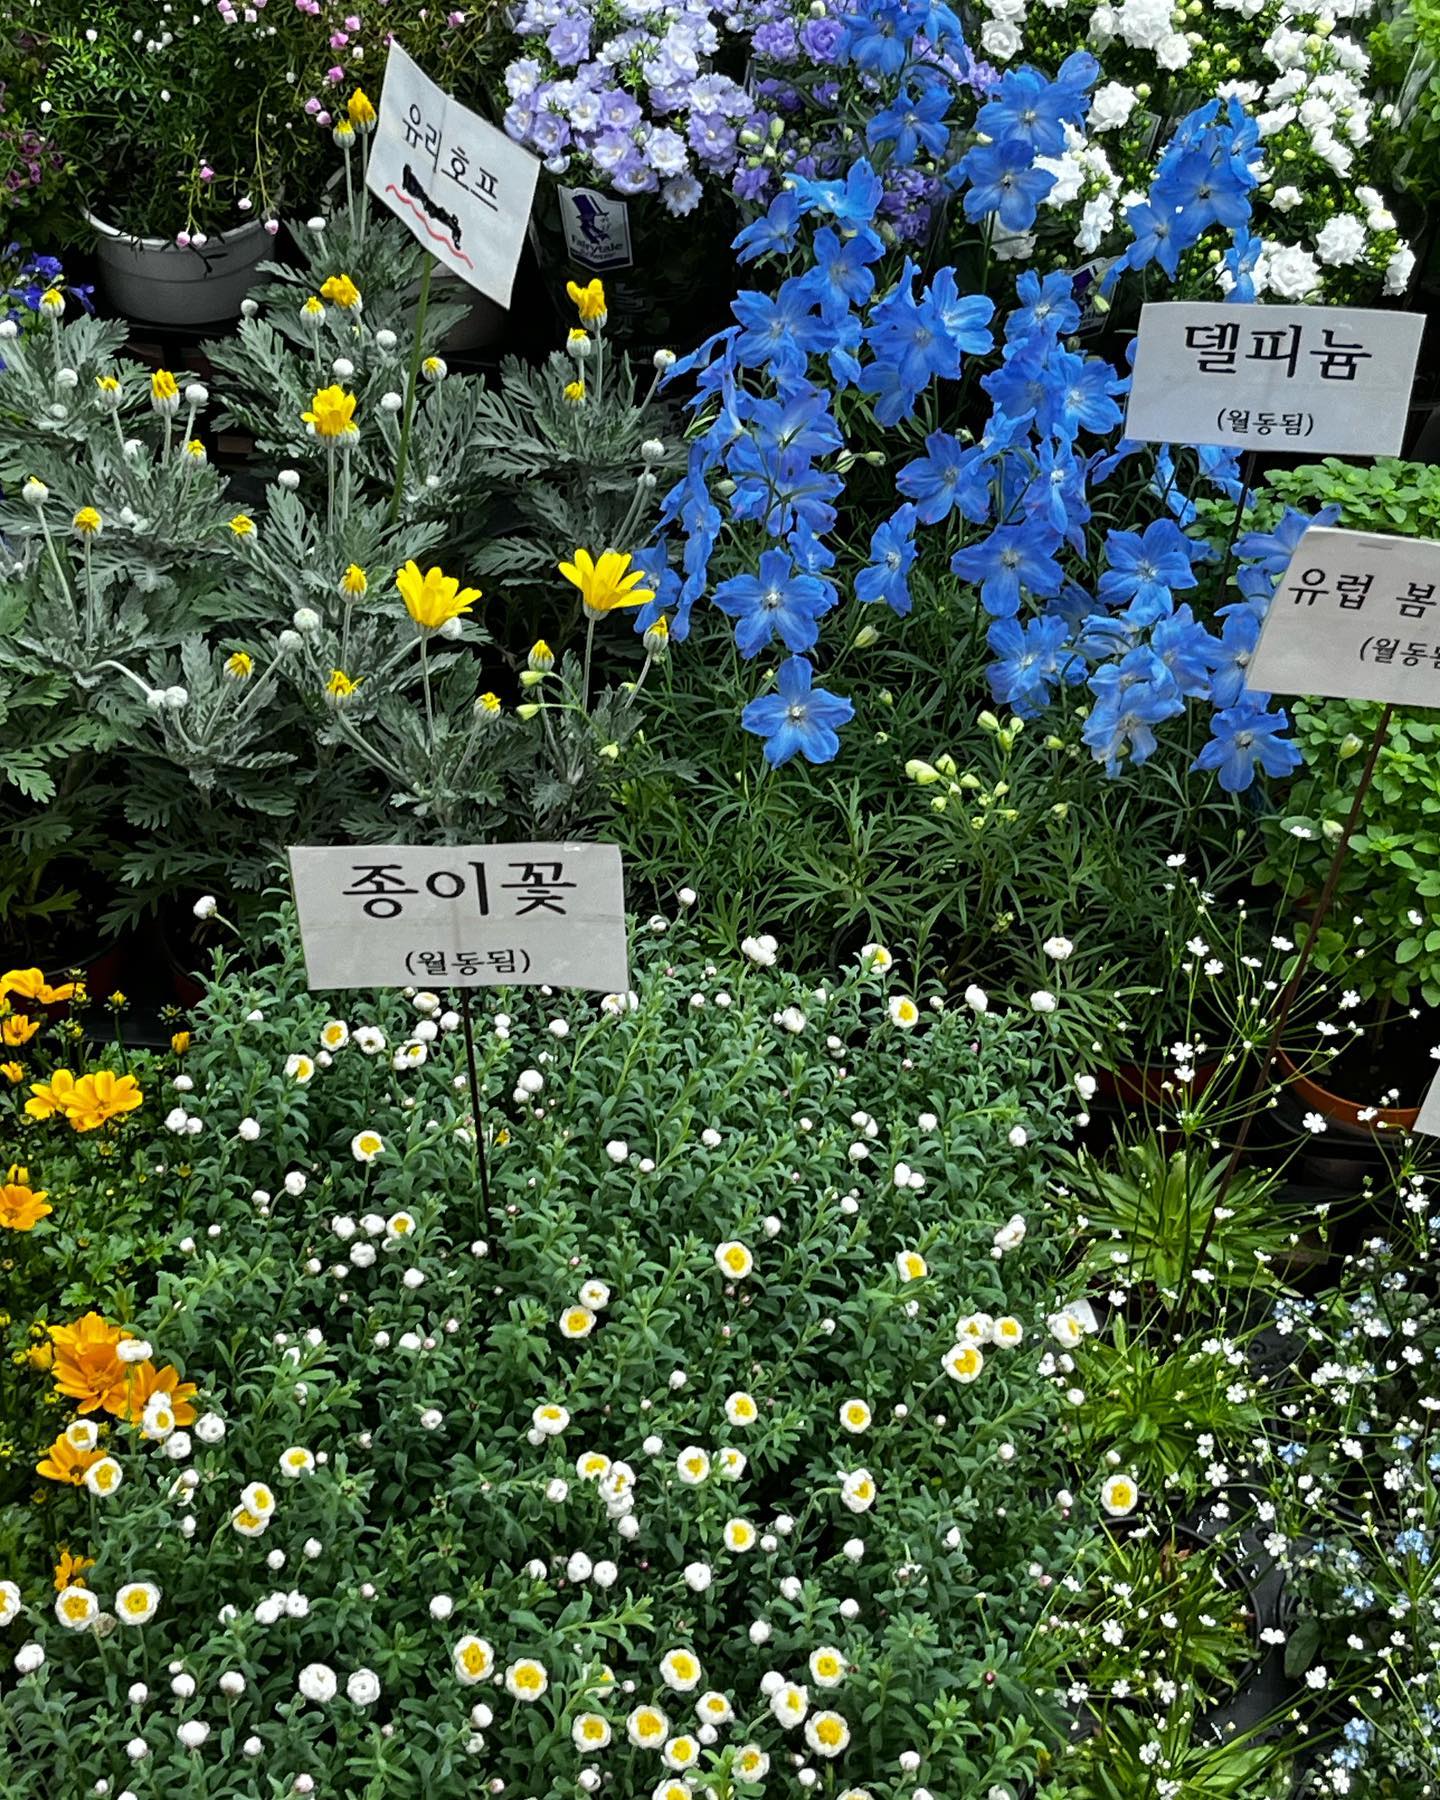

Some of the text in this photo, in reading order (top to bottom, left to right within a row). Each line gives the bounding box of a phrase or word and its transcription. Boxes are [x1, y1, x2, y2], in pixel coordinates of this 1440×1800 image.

[402, 103, 499, 212] 유리호프
[1185, 322, 1373, 380] 델피늄
[1217, 408, 1314, 437] (월동됨)
[1287, 568, 1437, 619] 유럽 봄
[342, 861, 578, 918] 종이꽃
[405, 949, 531, 976] (월동됨)
